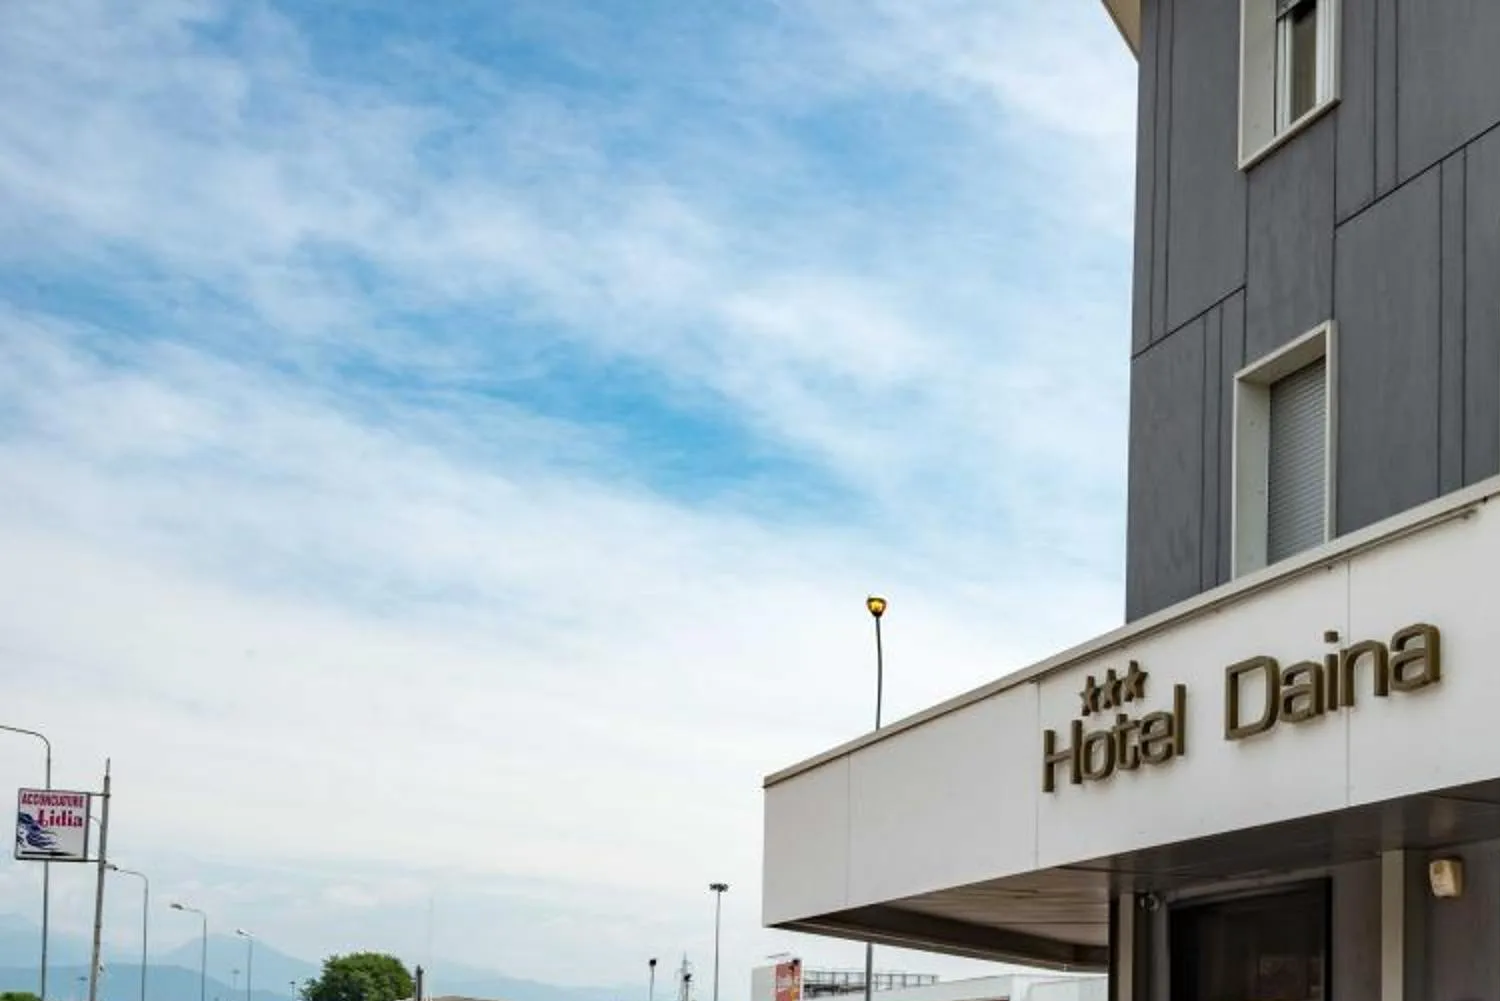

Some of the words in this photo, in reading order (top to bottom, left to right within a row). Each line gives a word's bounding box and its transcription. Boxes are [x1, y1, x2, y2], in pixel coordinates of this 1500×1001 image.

[1042, 684, 1187, 793] Hotel
[1224, 622, 1442, 741] Daina
[37, 808, 83, 828] Lidia
